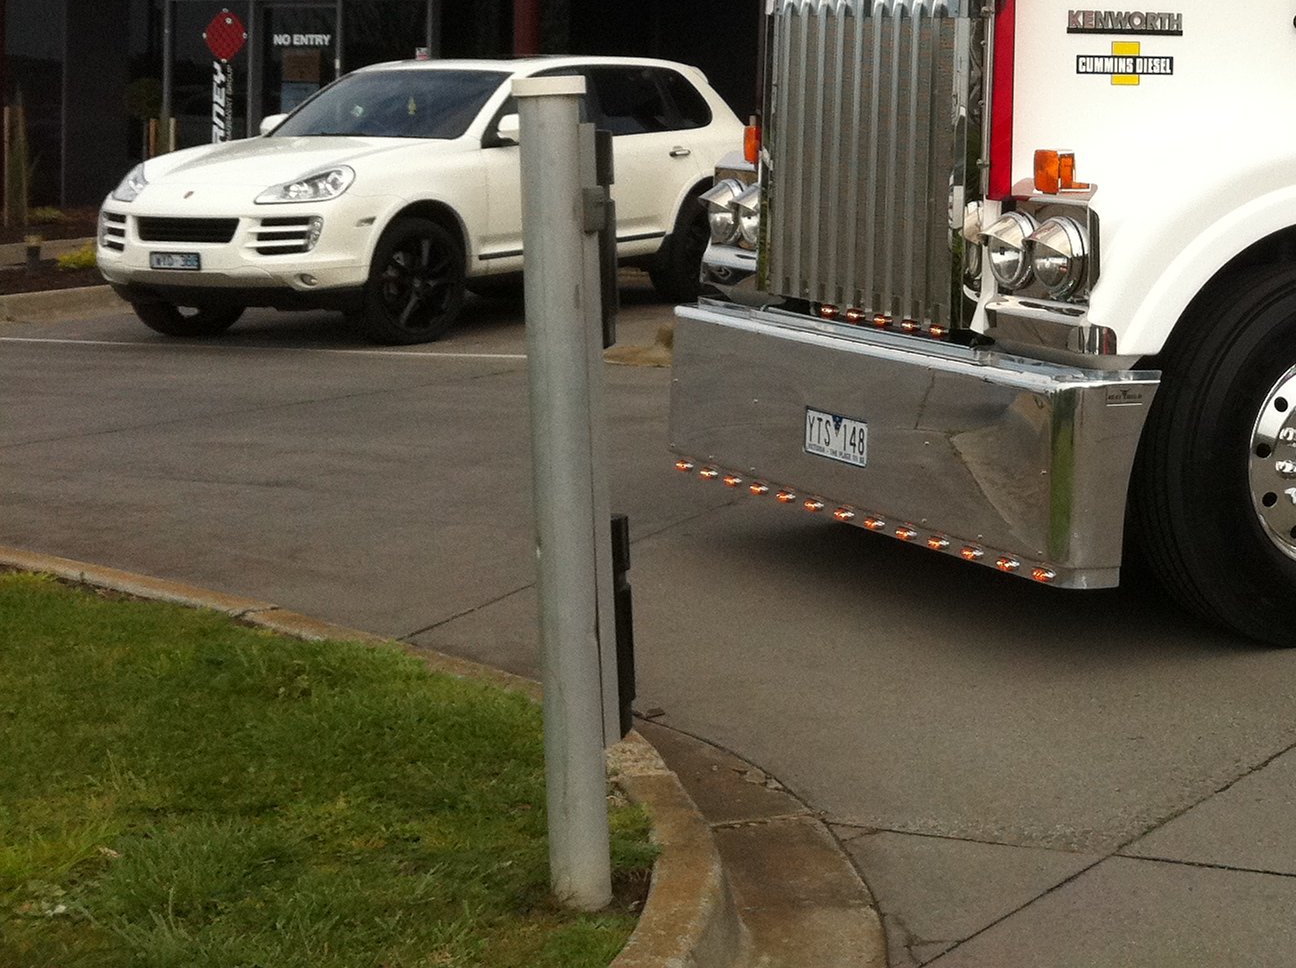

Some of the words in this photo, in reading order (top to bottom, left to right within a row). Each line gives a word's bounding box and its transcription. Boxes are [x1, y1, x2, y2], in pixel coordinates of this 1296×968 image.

[1068, 10, 1182, 30] KENWORTH
[273, 34, 291, 45] NO
[292, 34, 331, 45] ENTRY
[1078, 57, 1134, 73] CUMMINS
[1135, 58, 1172, 73] DIESEL
[212, 60, 226, 144] RNEY
[808, 415, 831, 446] YTS
[844, 424, 865, 455] 148
